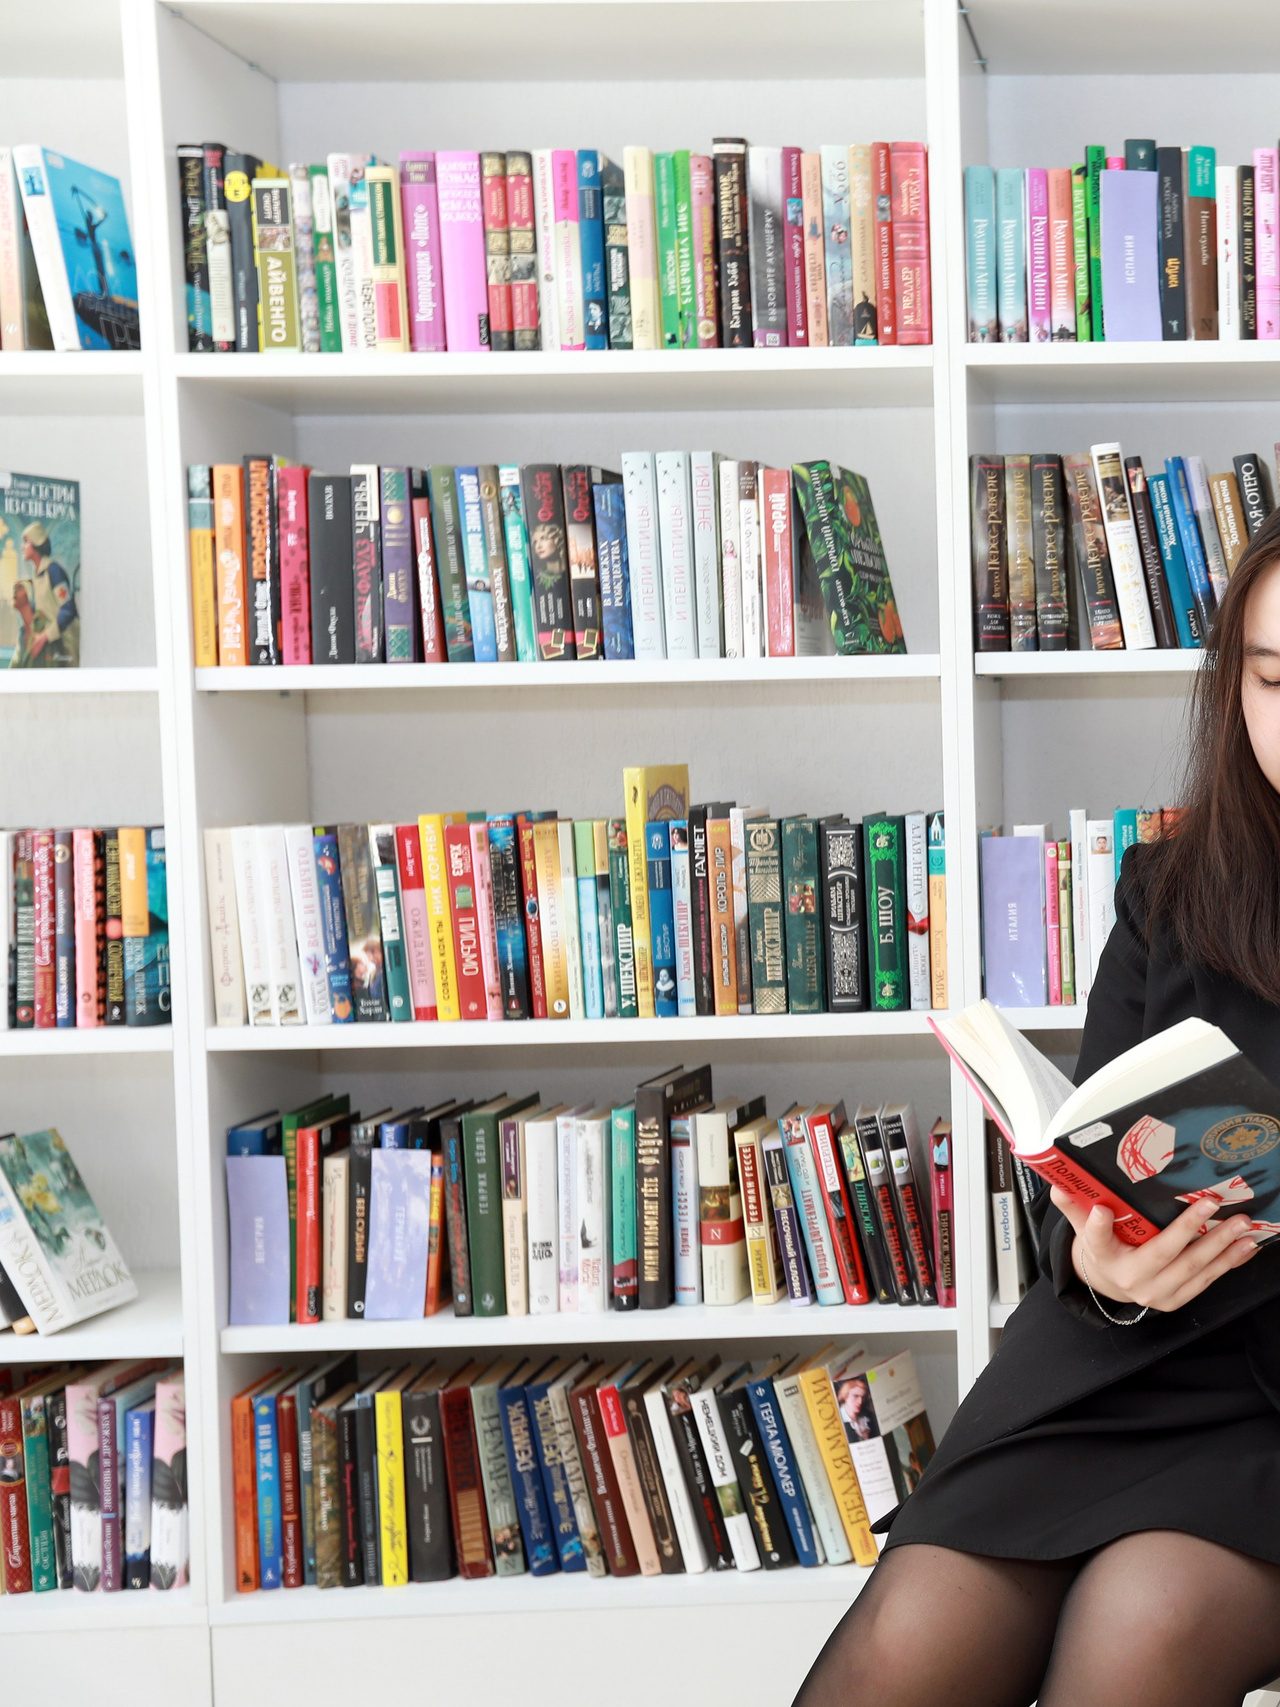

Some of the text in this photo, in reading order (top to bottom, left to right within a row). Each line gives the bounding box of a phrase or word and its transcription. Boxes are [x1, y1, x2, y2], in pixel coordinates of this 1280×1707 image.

[764, 209, 777, 322] ВЫЗОВИТЕ АКУШЕРКУ
[1124, 235, 1136, 283] ИСПАНИЯ
[267, 256, 287, 343] АЙВЕНГО
[902, 267, 913, 309] ВЕЛЛЕР
[355, 481, 369, 533] ЧЕРВЬ
[695, 466, 712, 532] ЭНГЛБИ
[1241, 463, 1261, 505] ОТЕРО
[466, 505, 482, 532] МНЕ
[769, 493, 786, 533] ФРАЙ
[1158, 480, 1176, 546] Холодная кожа
[1218, 510, 1228, 532] Санчес
[1220, 480, 1241, 546] Золотые века
[1223, 534, 1233, 561] Альберт
[641, 565, 656, 621] И ПЕЛИ
[674, 565, 687, 621] И ПЕЛИ
[425, 824, 443, 915] НИК ХОРНБИ
[449, 843, 463, 876] ХЬЮЗ
[693, 826, 706, 877] ГАМЛЕТ
[911, 823, 923, 896] АЛАЯ ЛЕНТА
[715, 848, 727, 913] КОРОЛЬ ЛИР
[304, 904, 314, 915] И
[543, 848, 562, 992] АНГЛИЙСКАЯ ПОРТНИХА
[677, 901, 689, 949] ШЕКСПИР
[878, 886, 894, 944] Б. ШОУ
[1008, 902, 1019, 941] ИТАЛИЯ
[411, 907, 427, 984] ОЖИДАНИЕ
[458, 917, 478, 976] ПИСЬМО
[617, 924, 636, 1009] У. ШЕКСПИР
[720, 924, 728, 956] ШЕКСПИР
[763, 908, 782, 983] ШЕКСПИР
[935, 970, 945, 1003] ЭМИС
[475, 1129, 488, 1215] ГЕНРИХ БЁЛЛЬ
[742, 1148, 758, 1223] ГЕРМАН ГЕССЕ
[817, 1129, 837, 1188] АУСТЕРЛИЦ
[1049, 1159, 1100, 1200] Полиция
[677, 1191, 689, 1223] ГЕССЕ
[801, 1190, 823, 1244] ДЮРРЕНМАТТ
[854, 1183, 875, 1236] ЗЮСКИНД
[996, 1197, 1011, 1252] Lovebook
[1124, 1217, 1147, 1238] Ёко
[755, 1250, 766, 1289] ДЕМИАН
[779, 1209, 801, 1297] ПЕСОЧНЫЙ ЧЕЛОВЕК
[507, 1400, 536, 1473] РЕМАРК
[700, 1398, 728, 1478] НЕМЕЦКИЙ ДОМ
[759, 1402, 795, 1496] ГЕРТА МЮЛЛЕР
[812, 1378, 866, 1526] БЕЛАЯ МАСАИ
